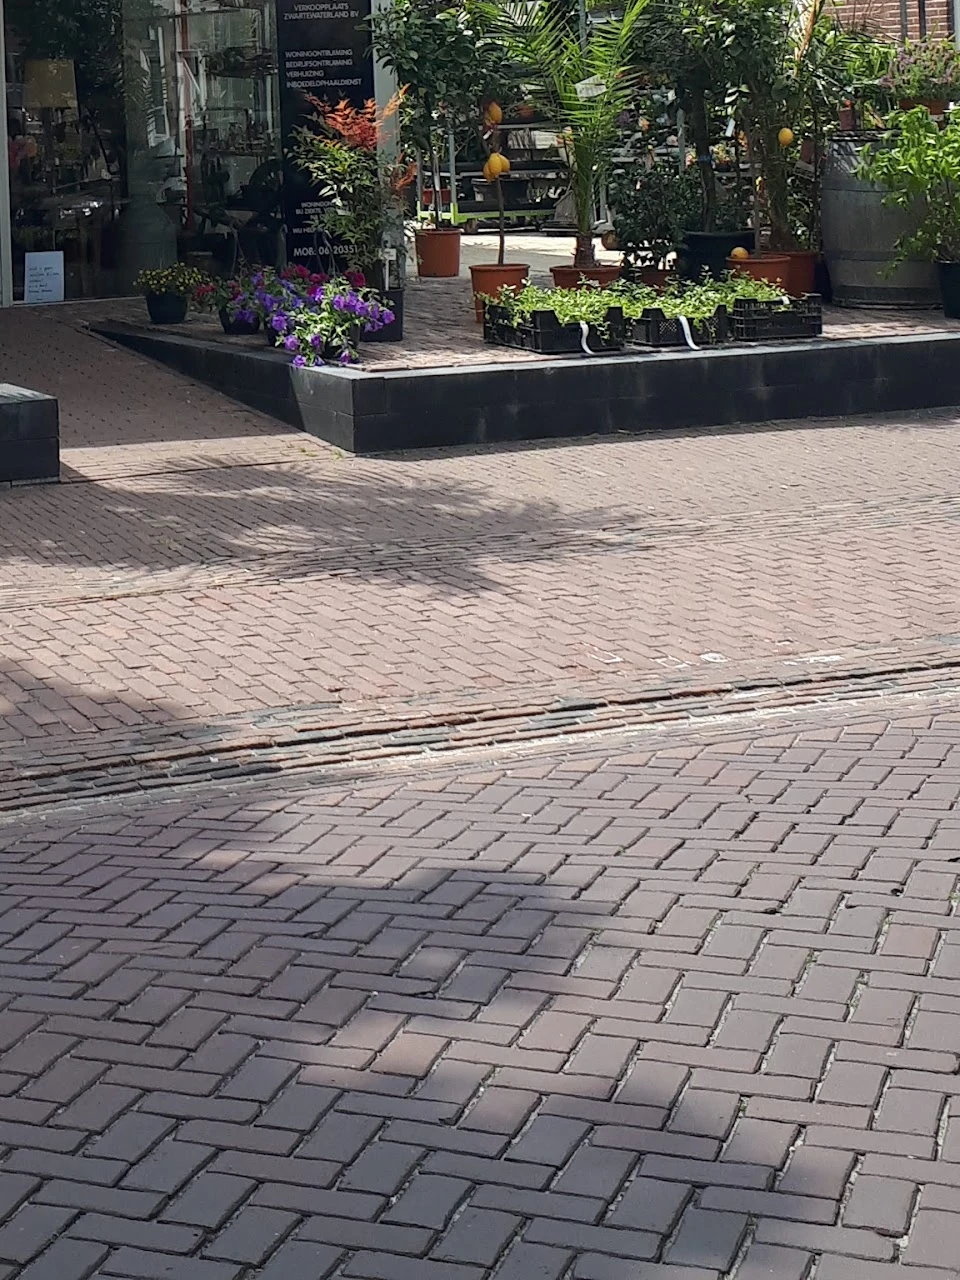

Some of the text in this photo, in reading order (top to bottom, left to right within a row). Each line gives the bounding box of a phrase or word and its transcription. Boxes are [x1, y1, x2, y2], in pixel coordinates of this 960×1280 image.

[294, 3, 349, 11] VERKOOPPLAATS
[284, 11, 349, 20] ZWARTEWATERLAND
[285, 49, 353, 58] WONINGONTRUIMING
[286, 70, 324, 78] VERHUIZING
